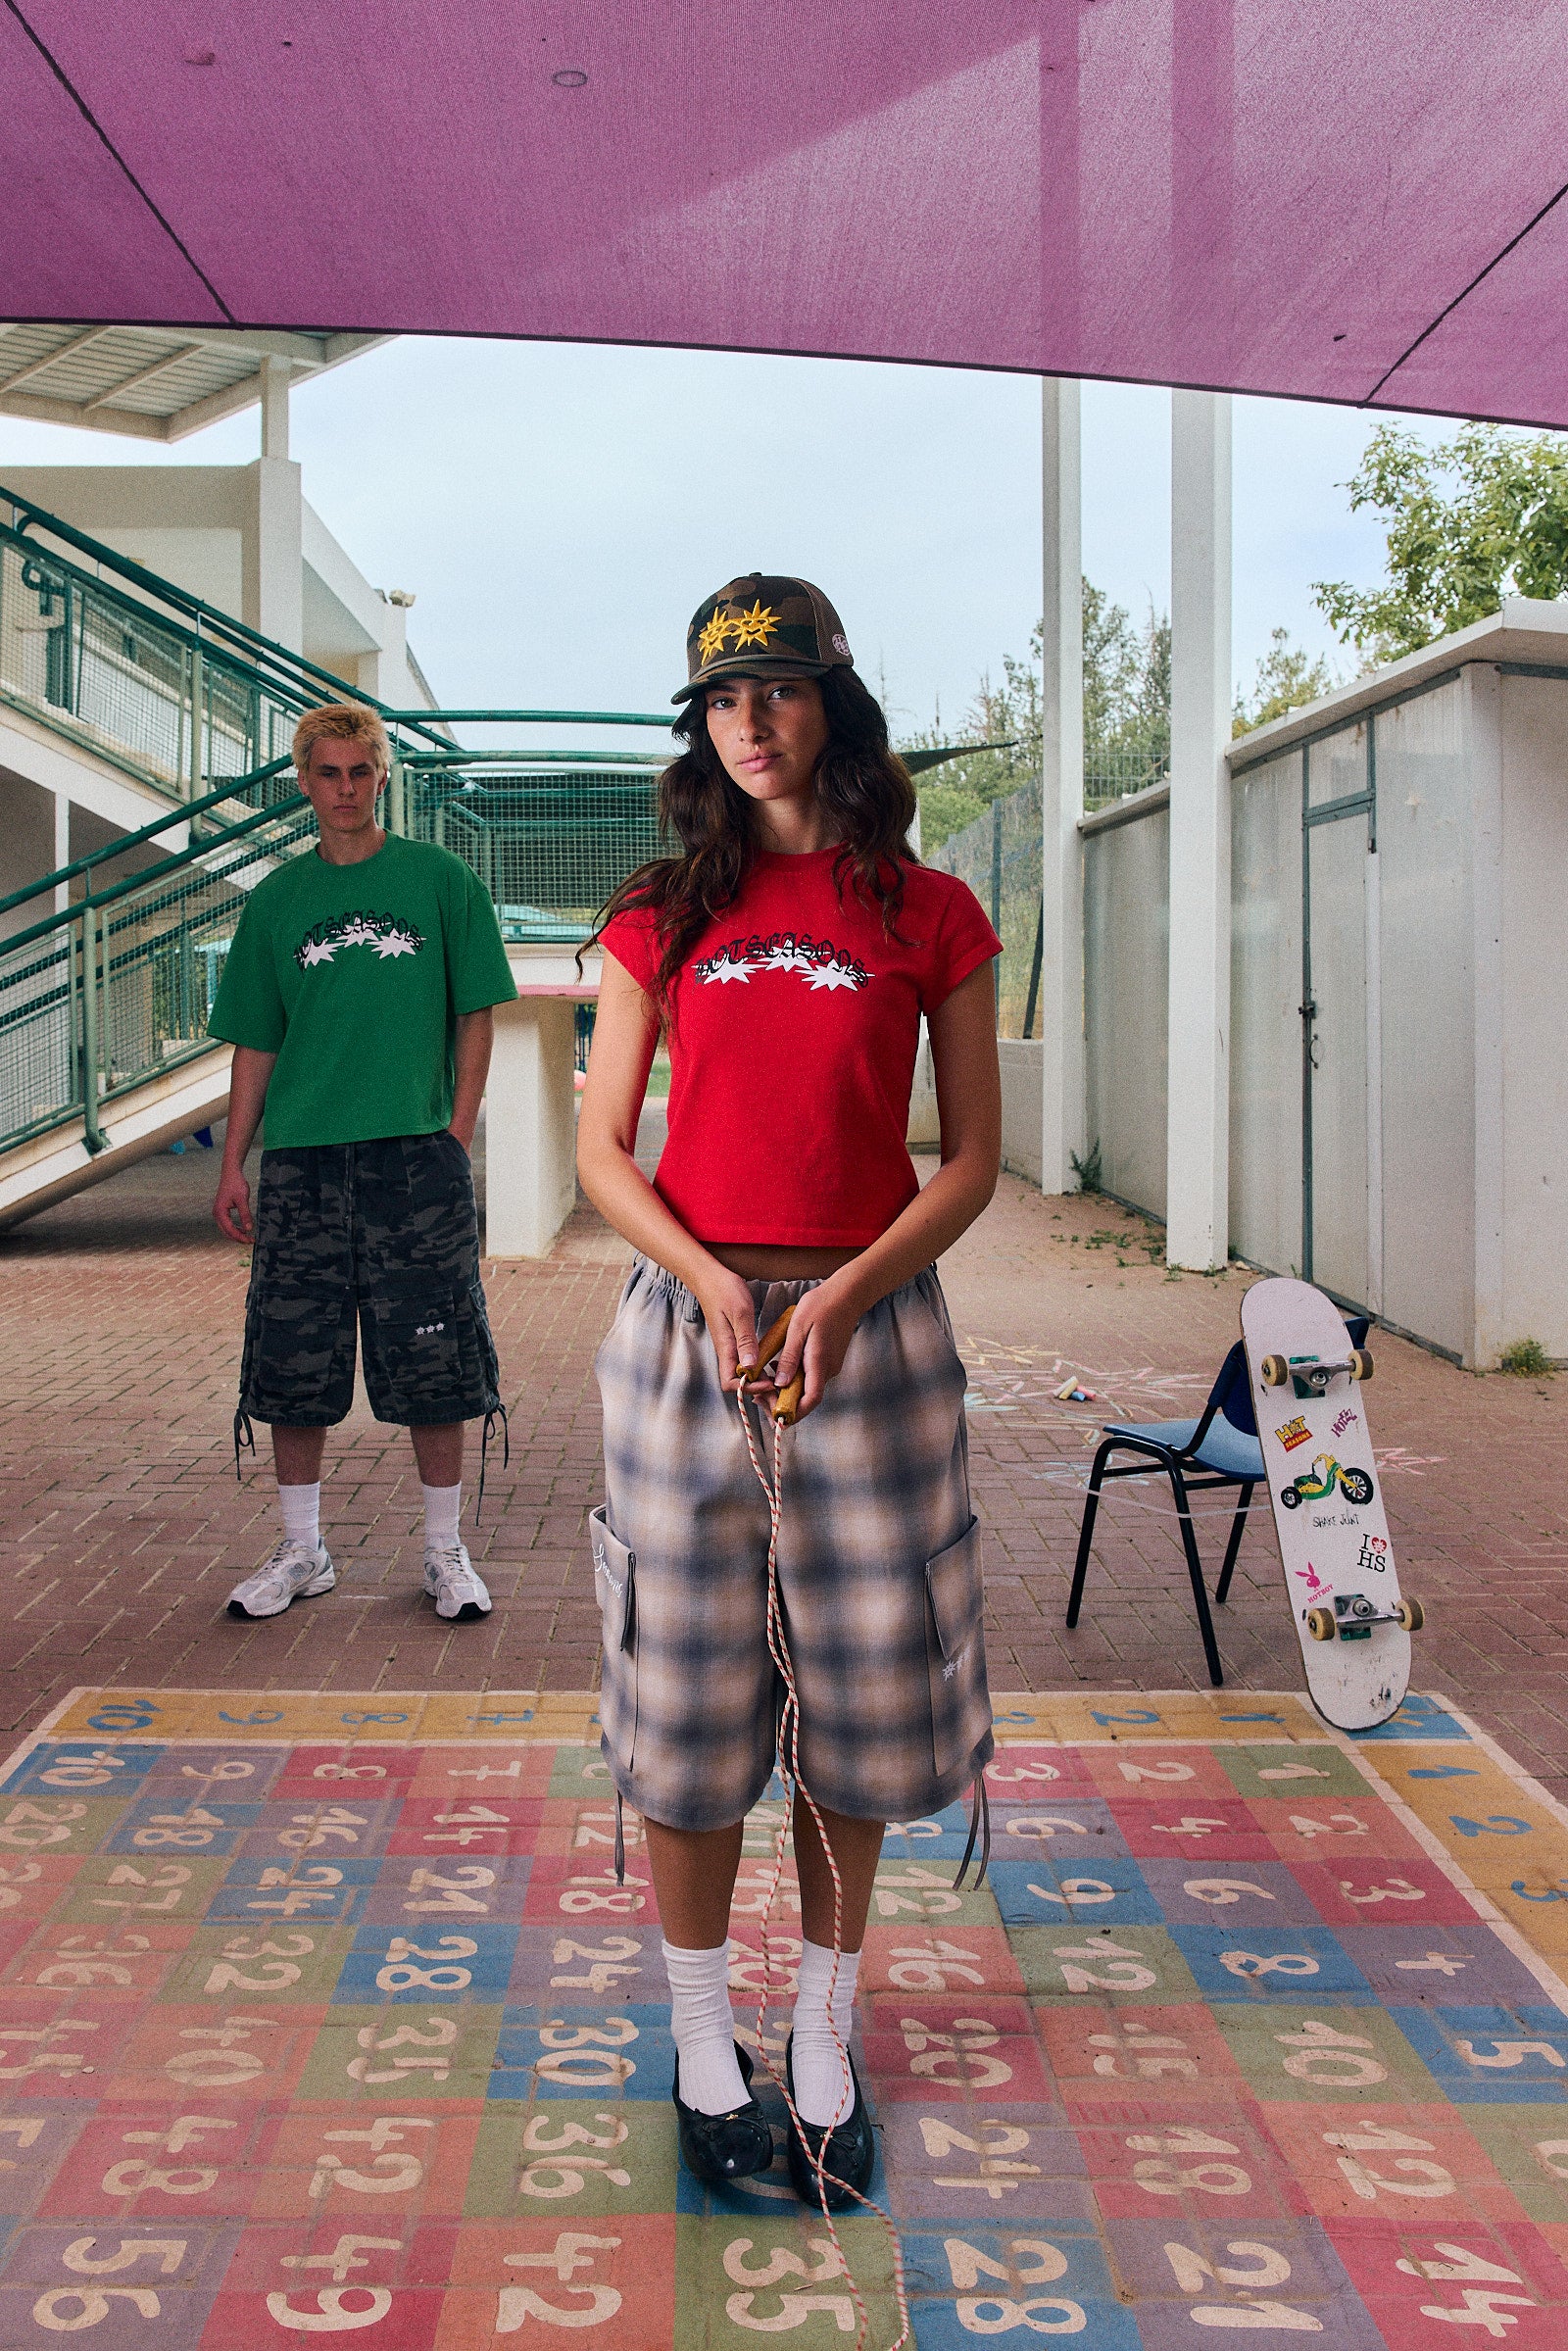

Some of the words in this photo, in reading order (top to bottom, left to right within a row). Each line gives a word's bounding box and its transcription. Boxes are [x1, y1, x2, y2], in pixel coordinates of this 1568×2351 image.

[1356, 1549, 1386, 1573] HS
[1361, 1533, 1370, 1550] I
[1307, 1584, 1333, 1603] HOTBOY
[88, 1699, 161, 1732] 10
[219, 1709, 283, 1726] 9
[341, 1710, 408, 1726] 8
[466, 1709, 534, 1726] 7
[1090, 1710, 1159, 1728] 2
[40, 1751, 125, 1787] 10
[182, 1761, 256, 1782] 9
[315, 1763, 386, 1781] 8
[449, 1761, 521, 1783] 7
[985, 1762, 1060, 1783] 3
[1116, 1762, 1197, 1783] 2
[132, 1808, 223, 1847] 18
[276, 1808, 368, 1849] 16
[422, 1806, 512, 1845] 14
[1005, 1818, 1087, 1837] 6
[1152, 1818, 1229, 1837] 4
[1448, 1816, 1533, 1837] 2
[92, 1866, 192, 1909] 27
[247, 1866, 344, 1915] 24
[404, 1867, 494, 1912] 21
[559, 1868, 651, 1912] 18
[874, 1867, 963, 1917] 12
[1027, 1878, 1114, 1903] 9
[1184, 1879, 1274, 1903] 6
[1340, 1879, 1425, 1903] 3
[204, 1934, 315, 1993] 32
[375, 1936, 477, 1991] 28
[550, 1936, 643, 1993] 24
[887, 1940, 984, 1991] 16
[1053, 1937, 1155, 1992] 12
[1219, 1952, 1320, 1977] 8
[165, 2017, 278, 2084] 40
[347, 2018, 458, 2082] 35
[535, 2017, 639, 2085] 30
[900, 2018, 1011, 2087] 20
[1274, 2022, 1388, 2086] 10
[1457, 2039, 1566, 2068] 5
[102, 2116, 237, 2196] 48
[310, 2117, 434, 2197] 42
[522, 2115, 630, 2198] 36
[918, 2118, 1042, 2200] 24
[1126, 2128, 1251, 2196] 18
[1323, 2121, 1457, 2198] 12
[33, 2236, 187, 2330] 56
[267, 2232, 403, 2332] 49
[495, 2232, 621, 2334] 42
[723, 2236, 855, 2332] 35
[944, 2238, 1087, 2335] 28
[1164, 2241, 1323, 2331] 21
[1396, 2241, 1538, 2337] 14
